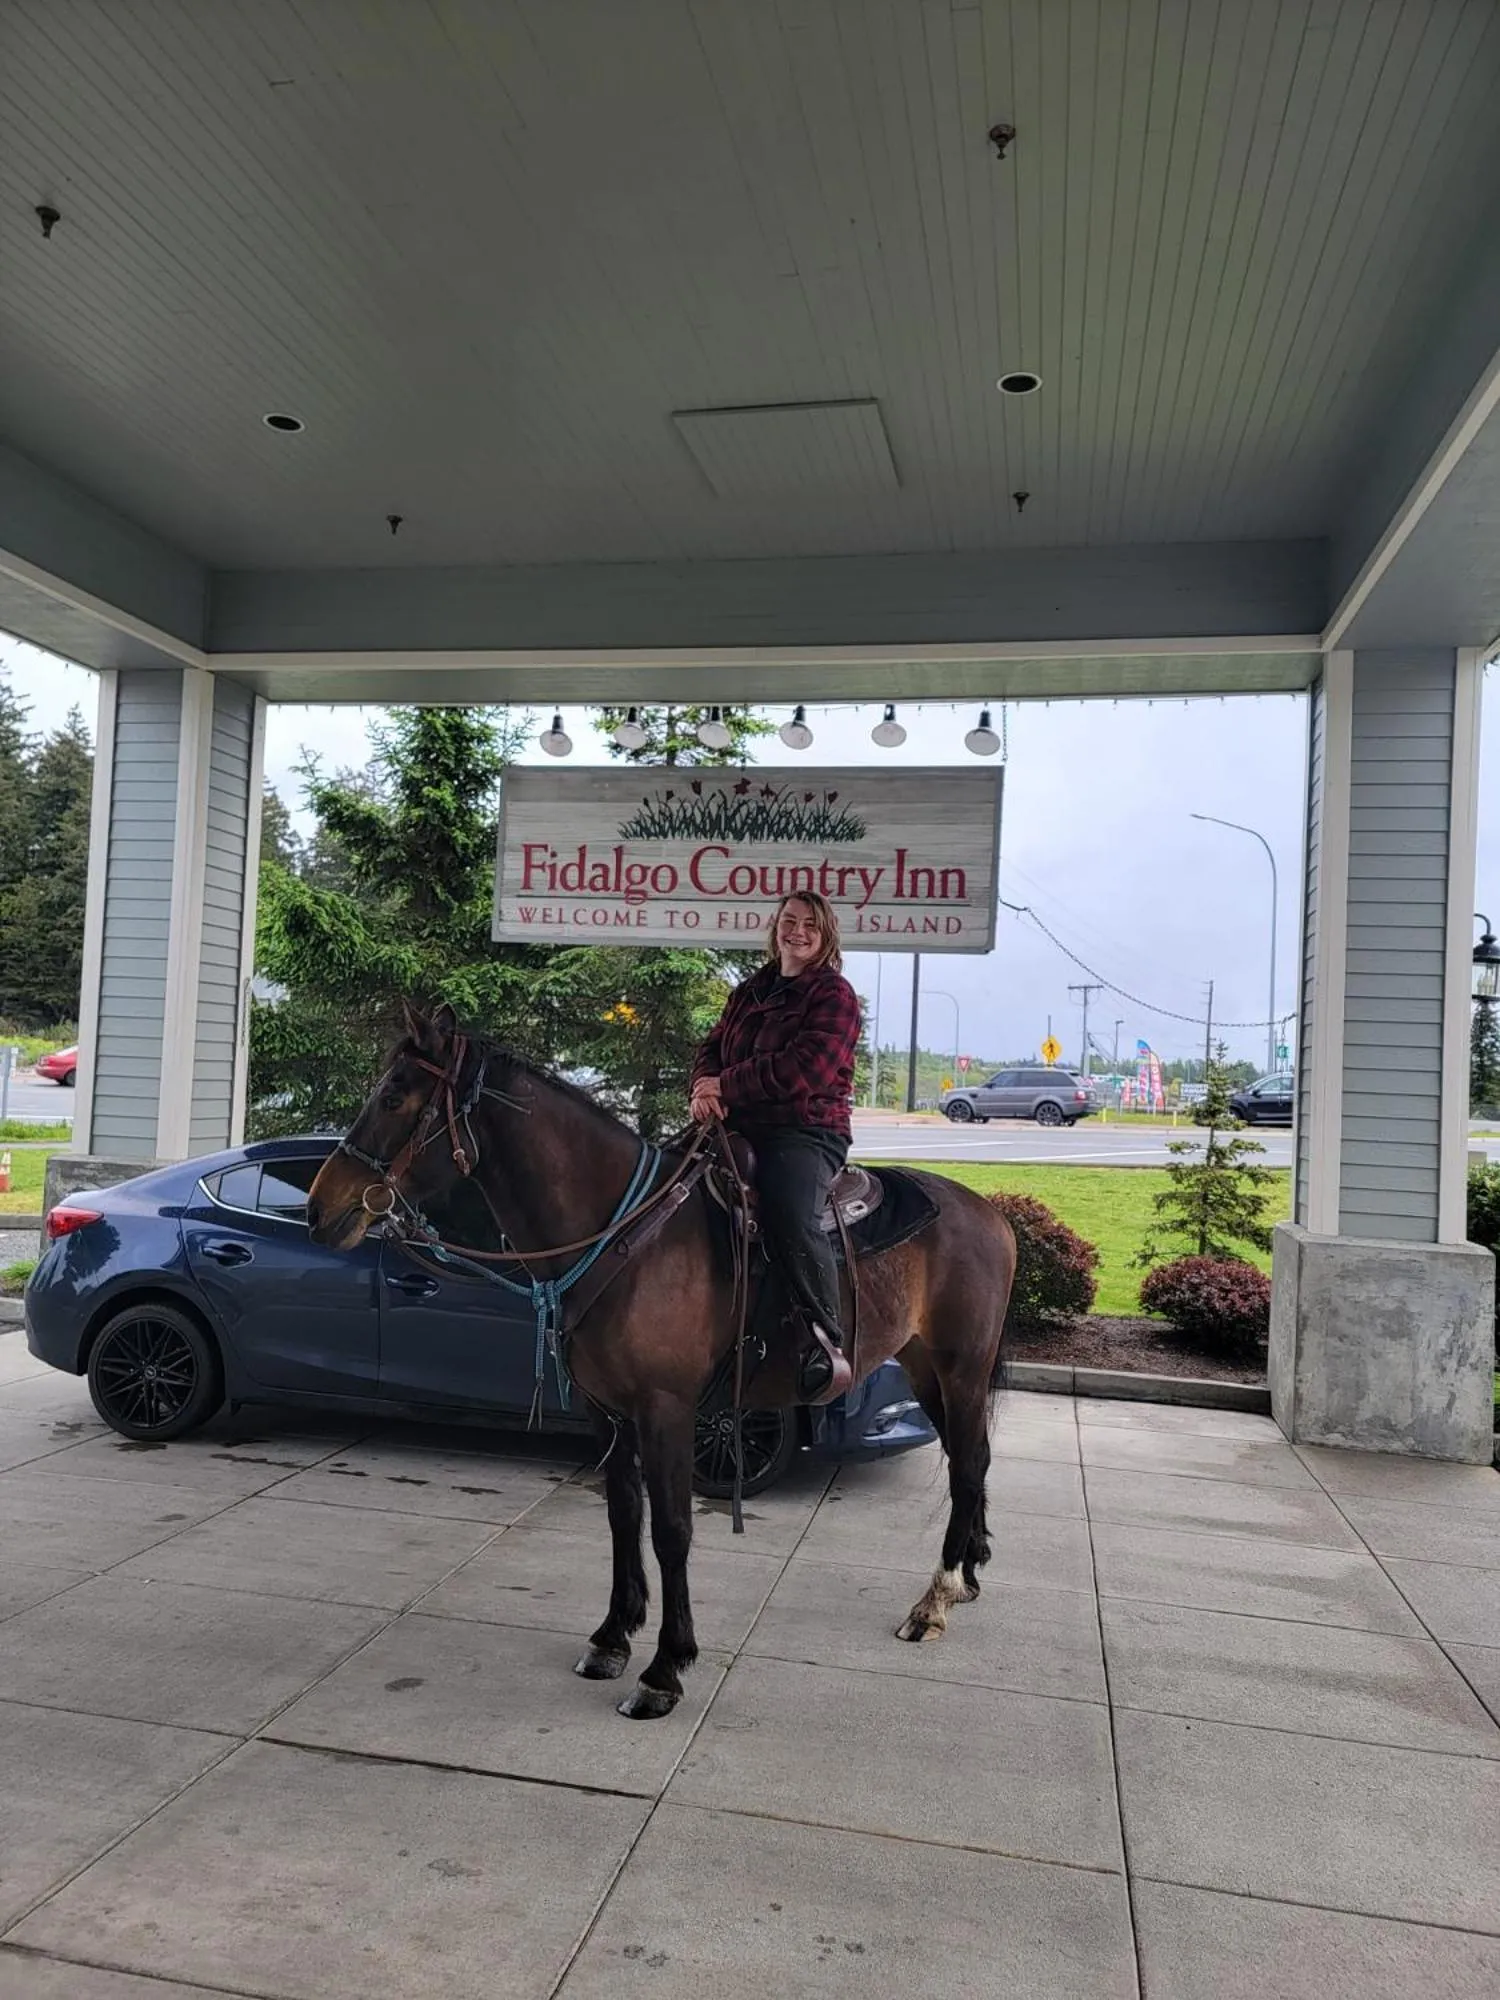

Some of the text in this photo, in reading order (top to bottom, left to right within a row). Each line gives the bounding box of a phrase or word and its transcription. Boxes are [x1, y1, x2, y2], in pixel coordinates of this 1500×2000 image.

[519, 843, 967, 909] Fidalgo Country Inn
[518, 906, 649, 927] WELCOME
[664, 909, 701, 929] TO
[856, 913, 963, 935] ISLAND
